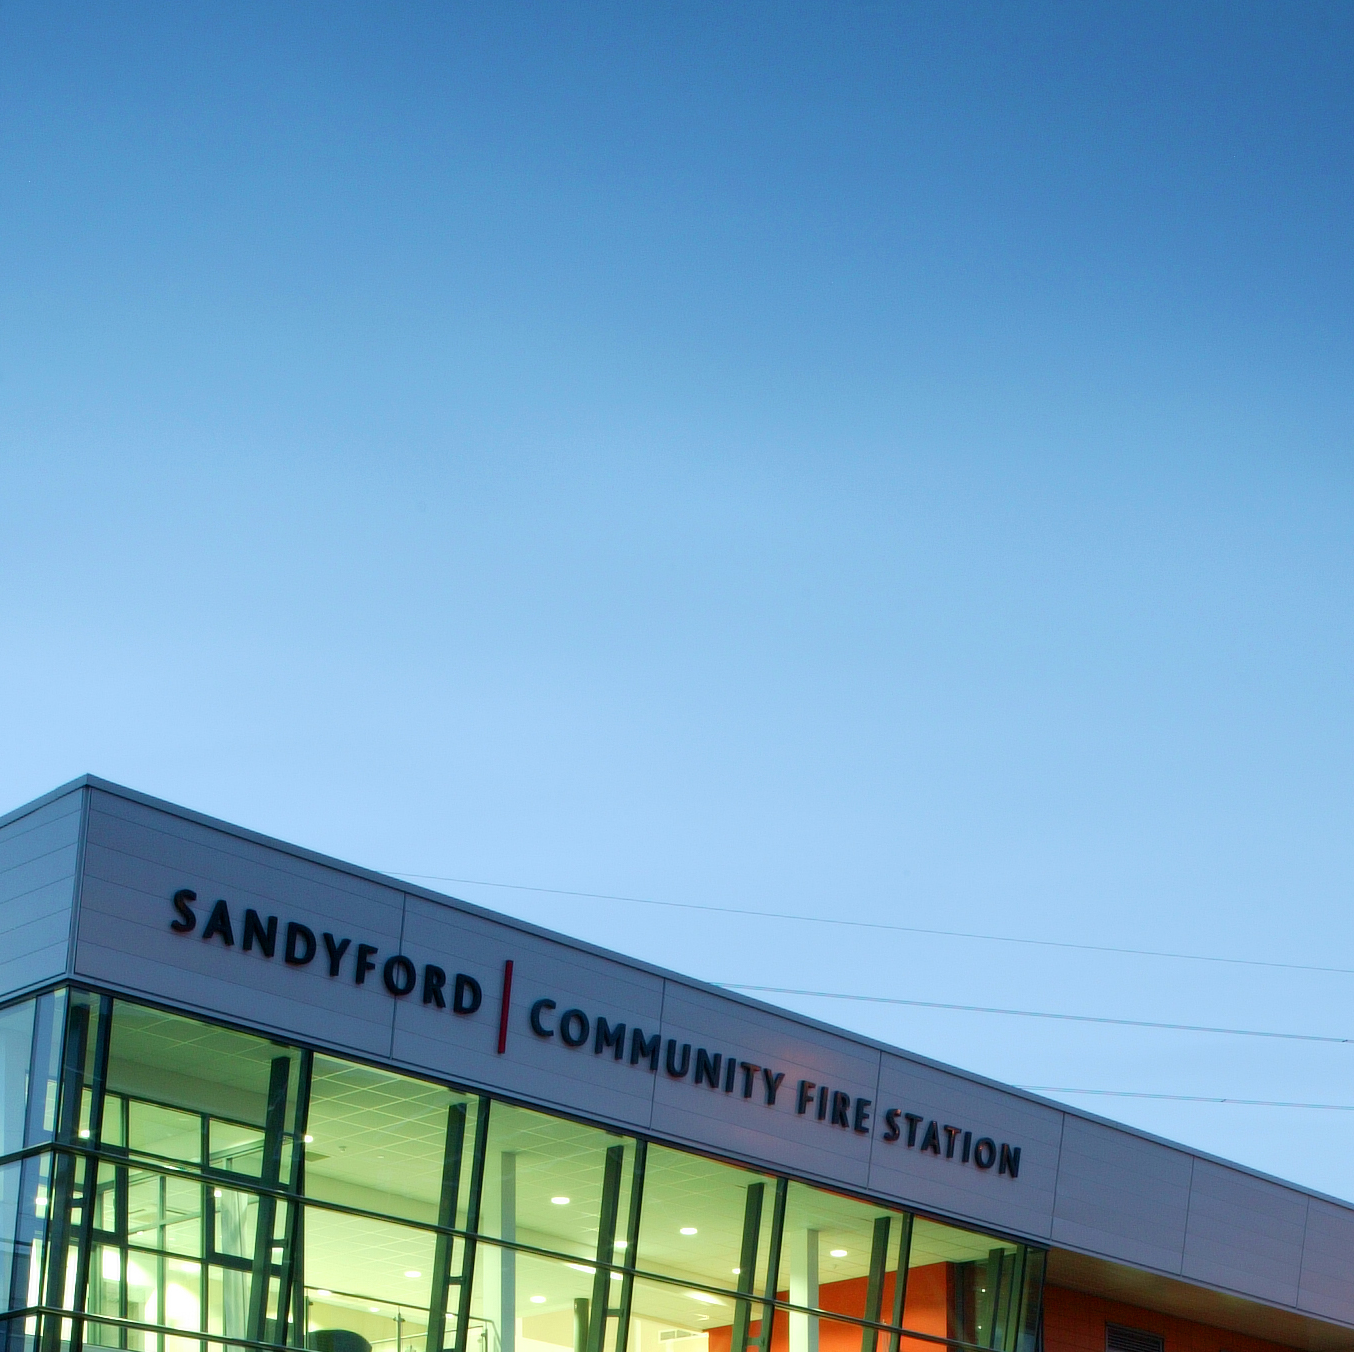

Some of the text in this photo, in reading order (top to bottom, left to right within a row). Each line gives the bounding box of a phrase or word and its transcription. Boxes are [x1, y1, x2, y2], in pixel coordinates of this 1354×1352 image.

[171, 889, 482, 1014] SANDYFORD
[530, 998, 1022, 1178] COMMUNITY FIRE STATION
